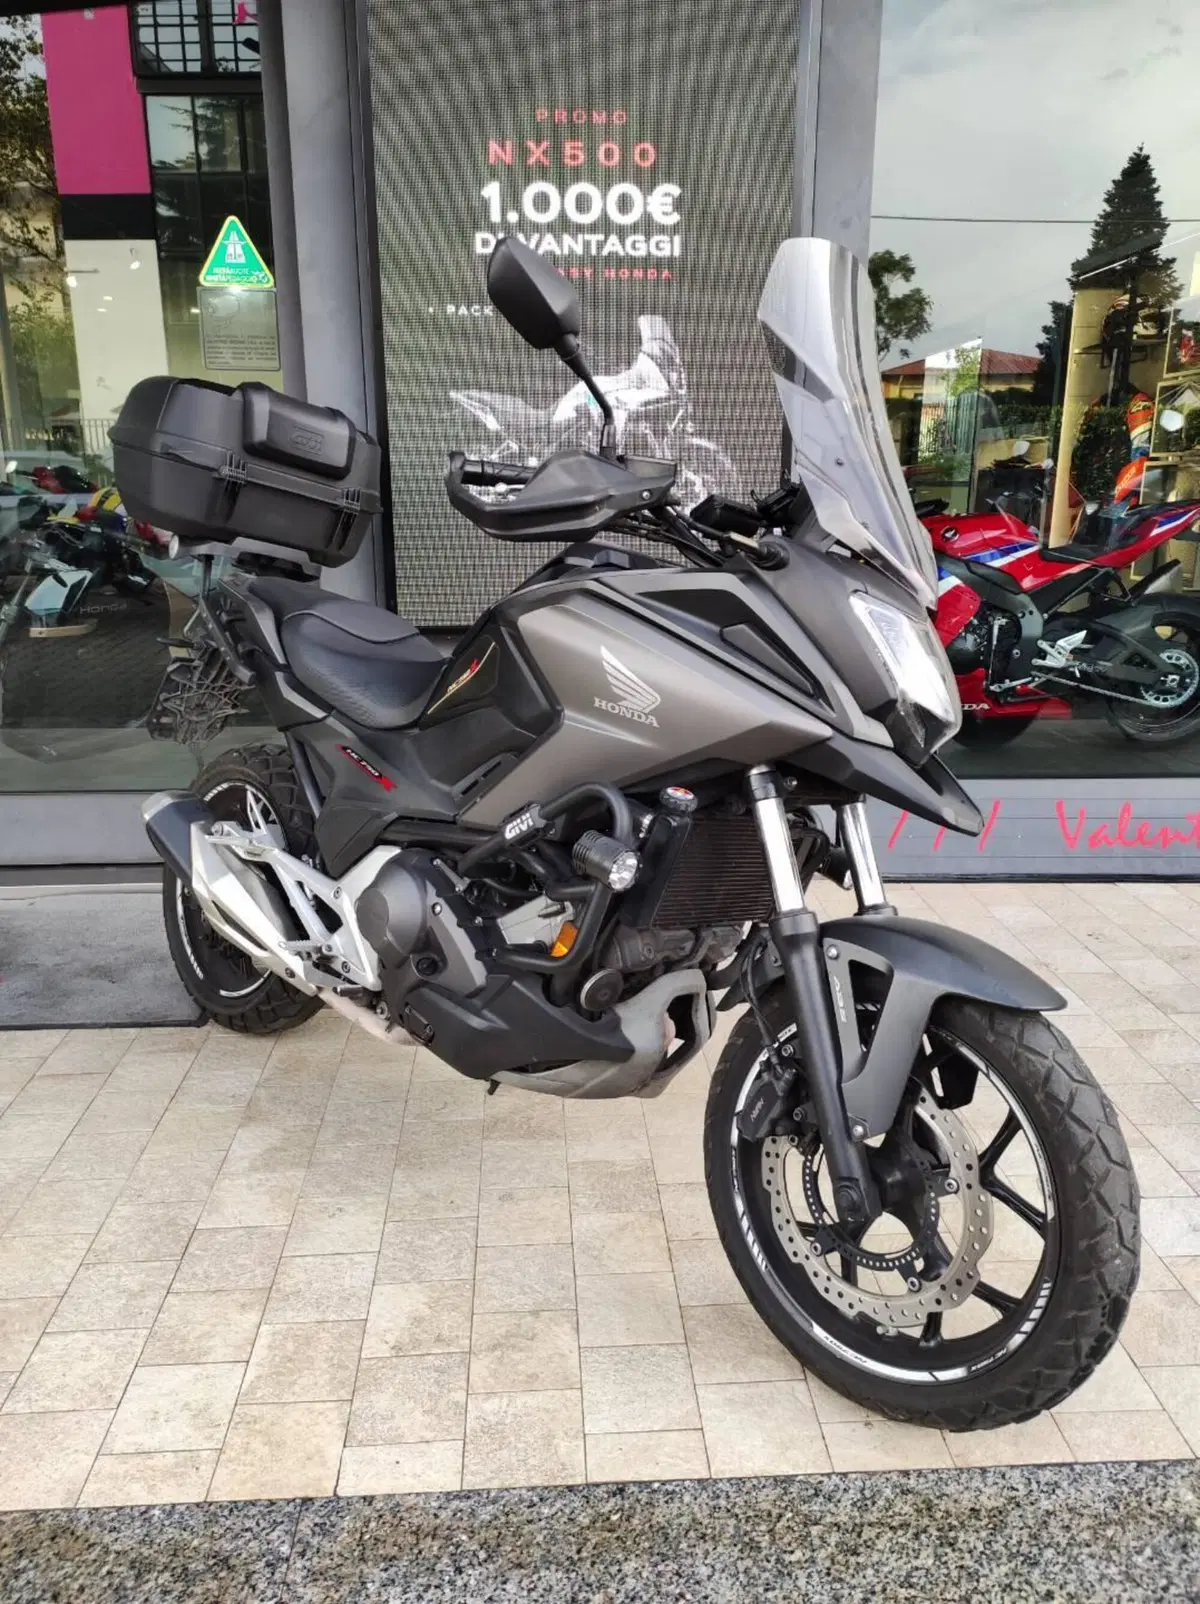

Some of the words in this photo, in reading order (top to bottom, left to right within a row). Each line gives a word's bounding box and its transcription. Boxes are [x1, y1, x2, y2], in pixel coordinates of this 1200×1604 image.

[535, 107, 628, 125] PROMO
[487, 139, 657, 168] NX500
[480, 181, 682, 225] 1.000€
[475, 232, 505, 254] D
[593, 696, 660, 728] HONDA
[504, 812, 534, 840] GIVI
